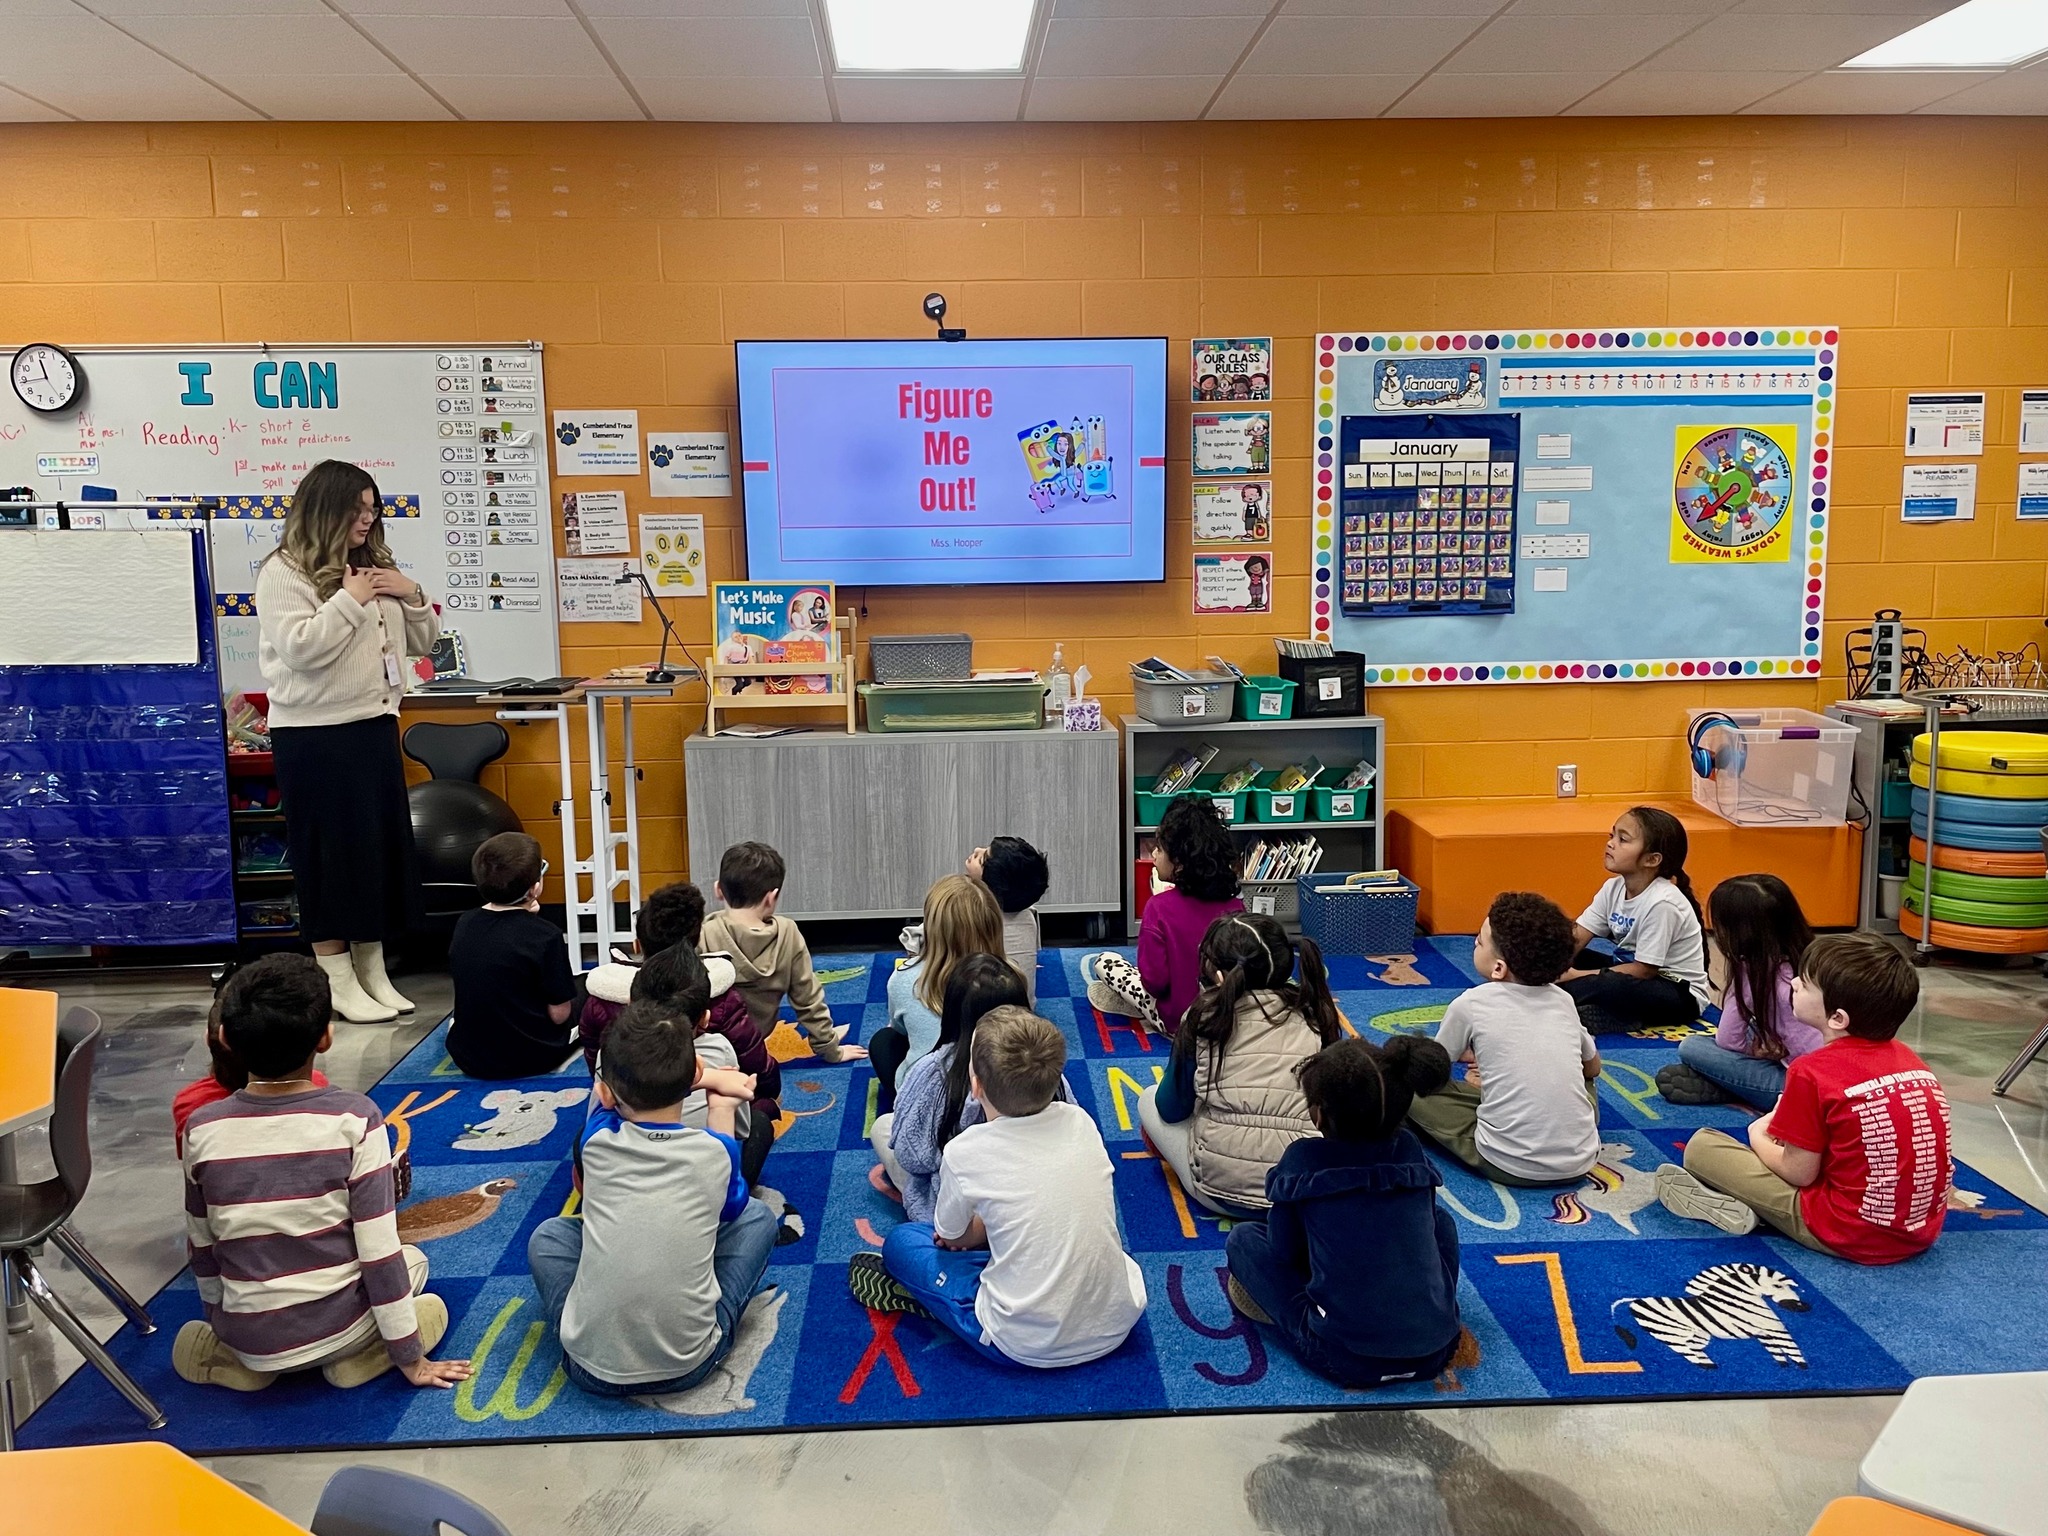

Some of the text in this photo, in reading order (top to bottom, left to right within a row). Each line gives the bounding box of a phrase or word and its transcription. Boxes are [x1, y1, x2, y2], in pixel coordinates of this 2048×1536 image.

[38, 350, 46, 359] 12
[1203, 352, 1261, 365] OUR CLASS
[22, 364, 31, 372] 10
[60, 360, 67, 368] 2
[498, 360, 528, 369] Arrival
[1215, 363, 1248, 374] RULES!
[21, 376, 28, 384] 9
[66, 371, 73, 380] 3
[66, 384, 72, 392] 4
[178, 361, 338, 409] I CAN
[1404, 374, 1460, 394] January
[1502, 380, 1509, 390] 0
[1532, 380, 1538, 390] 2
[1546, 380, 1552, 390] 3
[1560, 380, 1566, 390] 4
[1574, 380, 1580, 390] 5
[1589, 380, 1595, 389] 6
[1603, 380, 1609, 389] 7
[1617, 380, 1624, 389] 8
[1632, 380, 1638, 389] 9
[1643, 380, 1654, 389] 10
[1658, 380, 1666, 389] 11
[1673, 380, 1682, 389] 12
[1690, 380, 1698, 389] 13
[1705, 380, 1714, 389] 14
[1721, 380, 1730, 389] 15
[1736, 380, 1745, 389] 16
[1752, 380, 1761, 389] 17
[1768, 380, 1777, 389] 18
[1784, 380, 1793, 389] 19
[1798, 380, 1810, 389] 20
[27, 387, 34, 396] 8
[60, 393, 66, 401] 5
[37, 394, 43, 402] 7
[49, 396, 56, 405] 6
[898, 381, 994, 424] Figure
[500, 400, 533, 412] Reading
[260, 419, 293, 434] short
[582, 422, 633, 430] Cumberland Trace
[261, 433, 352, 449] make predictions
[592, 432, 624, 440] Elementary
[1704, 433, 1730, 448] snowy
[1744, 432, 1770, 447] cloudy
[503, 448, 530, 460] Lunch
[675, 444, 725, 452] Cumberland Trace
[923, 431, 970, 466] Me
[1390, 441, 1459, 458] January
[39, 457, 97, 468] OH YEAH
[684, 454, 717, 462] Elementary
[1212, 454, 1233, 462] talking
[261, 461, 287, 474] make
[291, 460, 308, 472] and
[1681, 460, 1693, 476] hot
[1778, 454, 1790, 482] windy
[508, 472, 532, 482] Math
[1348, 472, 1364, 480] Sun.
[1397, 470, 1415, 478] Tues.
[262, 477, 284, 492] spell
[919, 477, 977, 512] Out!
[1249, 507, 1256, 516] 7
[1773, 496, 1788, 520] sunny
[1210, 525, 1232, 533] quickly
[1702, 530, 1724, 542] rainy
[1740, 529, 1764, 543] foggy
[954, 538, 984, 550] Hooper
[1682, 531, 1782, 560] TODAY'S WEATHER
[506, 598, 540, 606] Dismissal
[720, 590, 785, 605] Let's Make
[730, 606, 776, 626] Music
[1494, 1252, 1644, 1376] Z
